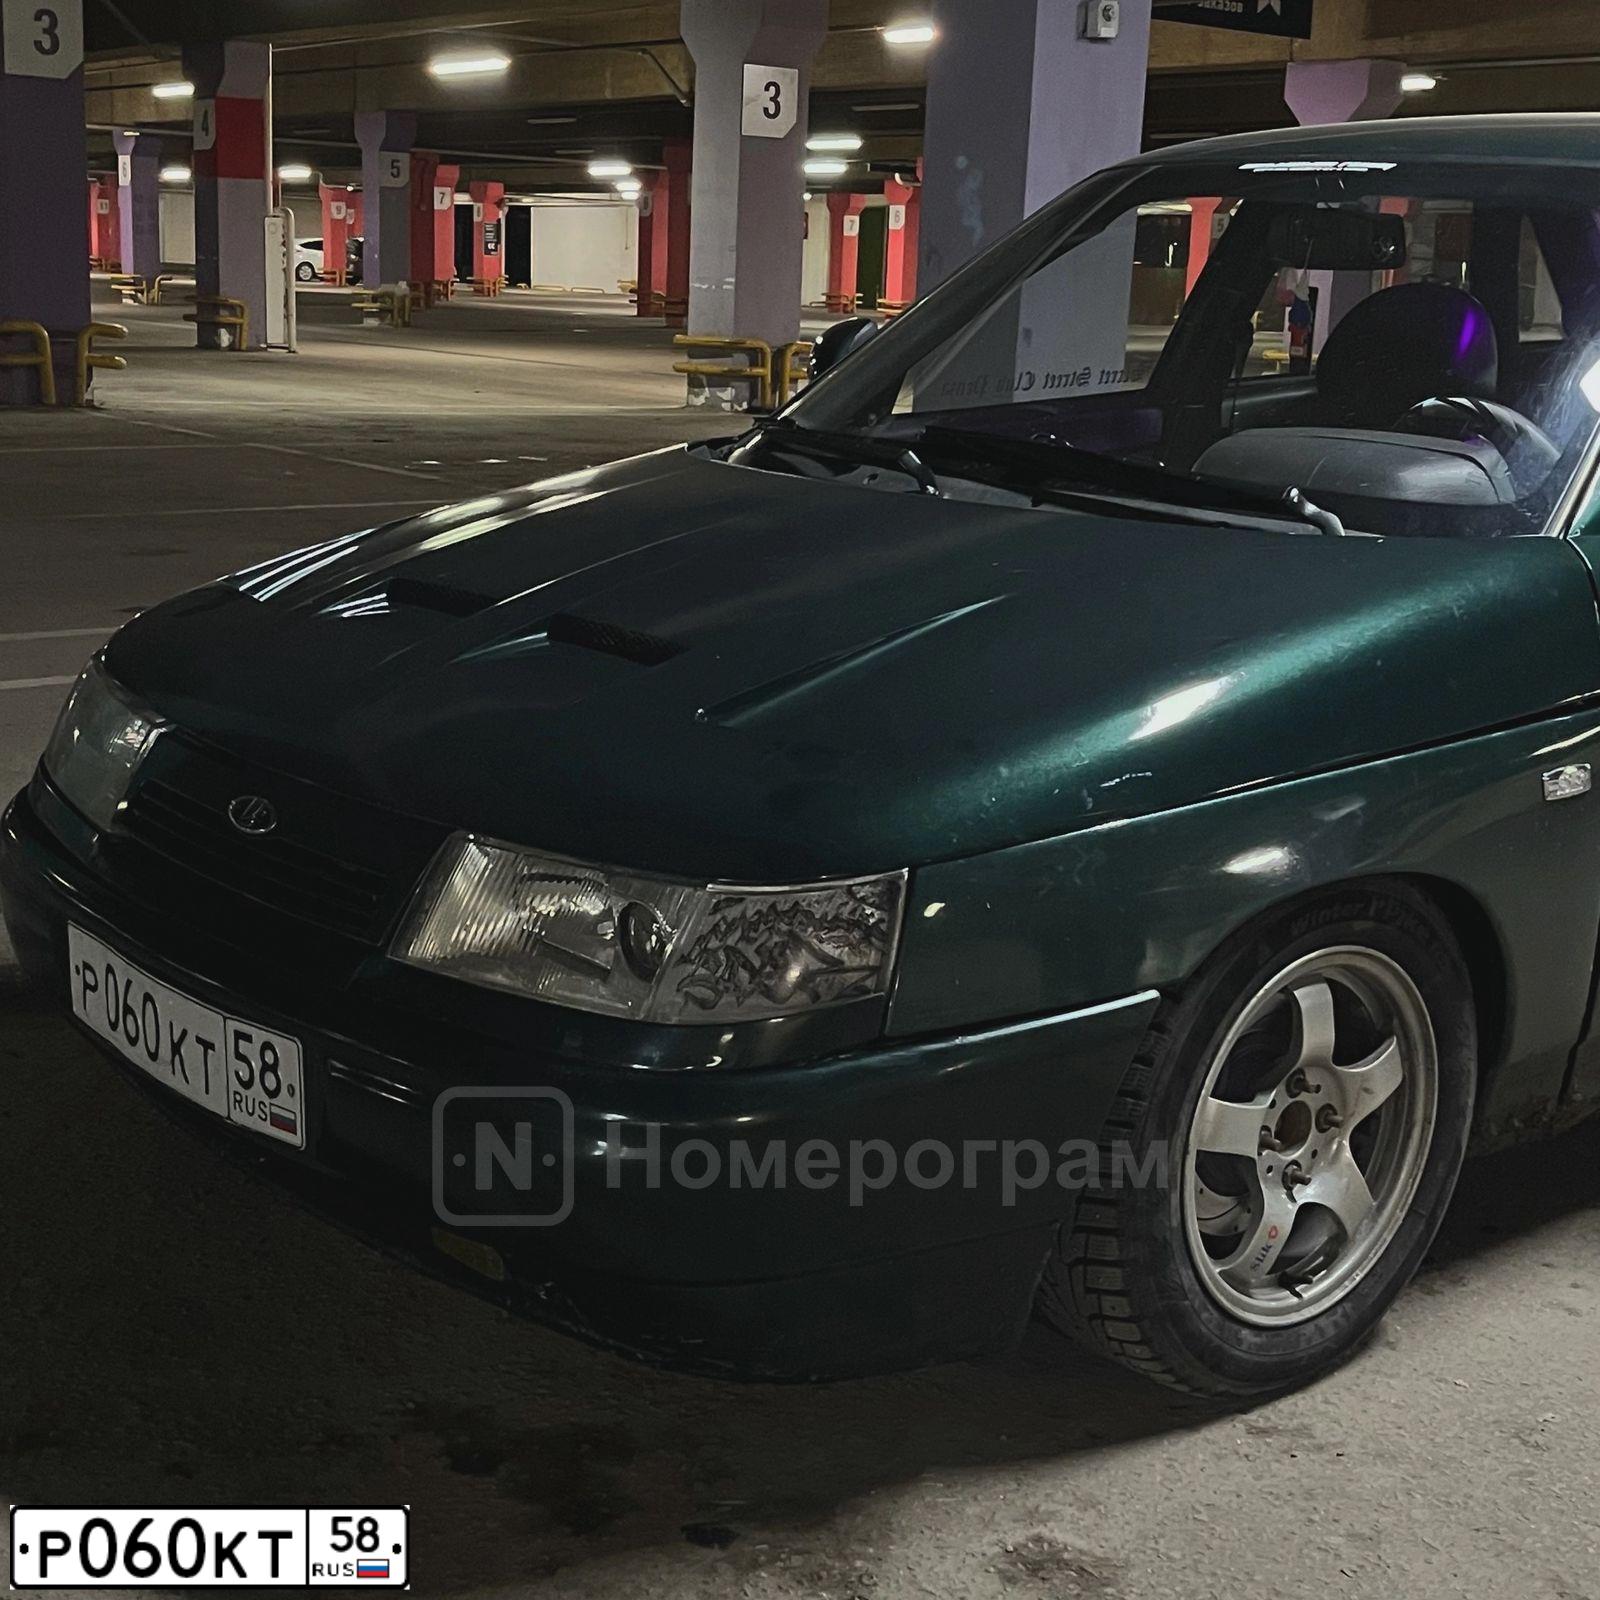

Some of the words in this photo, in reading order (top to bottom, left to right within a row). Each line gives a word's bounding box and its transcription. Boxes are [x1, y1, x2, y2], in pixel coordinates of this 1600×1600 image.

[34, 8, 59, 56] 3
[763, 81, 781, 119] 3
[202, 109, 209, 136] 4
[391, 159, 400, 178] 5
[439, 192, 446, 204] 7
[849, 220, 855, 231] 7
[895, 210, 902, 224] 6
[1217, 218, 1224, 232] 5
[82, 960, 216, 1096] Р060КТ
[233, 1029, 282, 1099] 58
[233, 1090, 268, 1122] RUS
